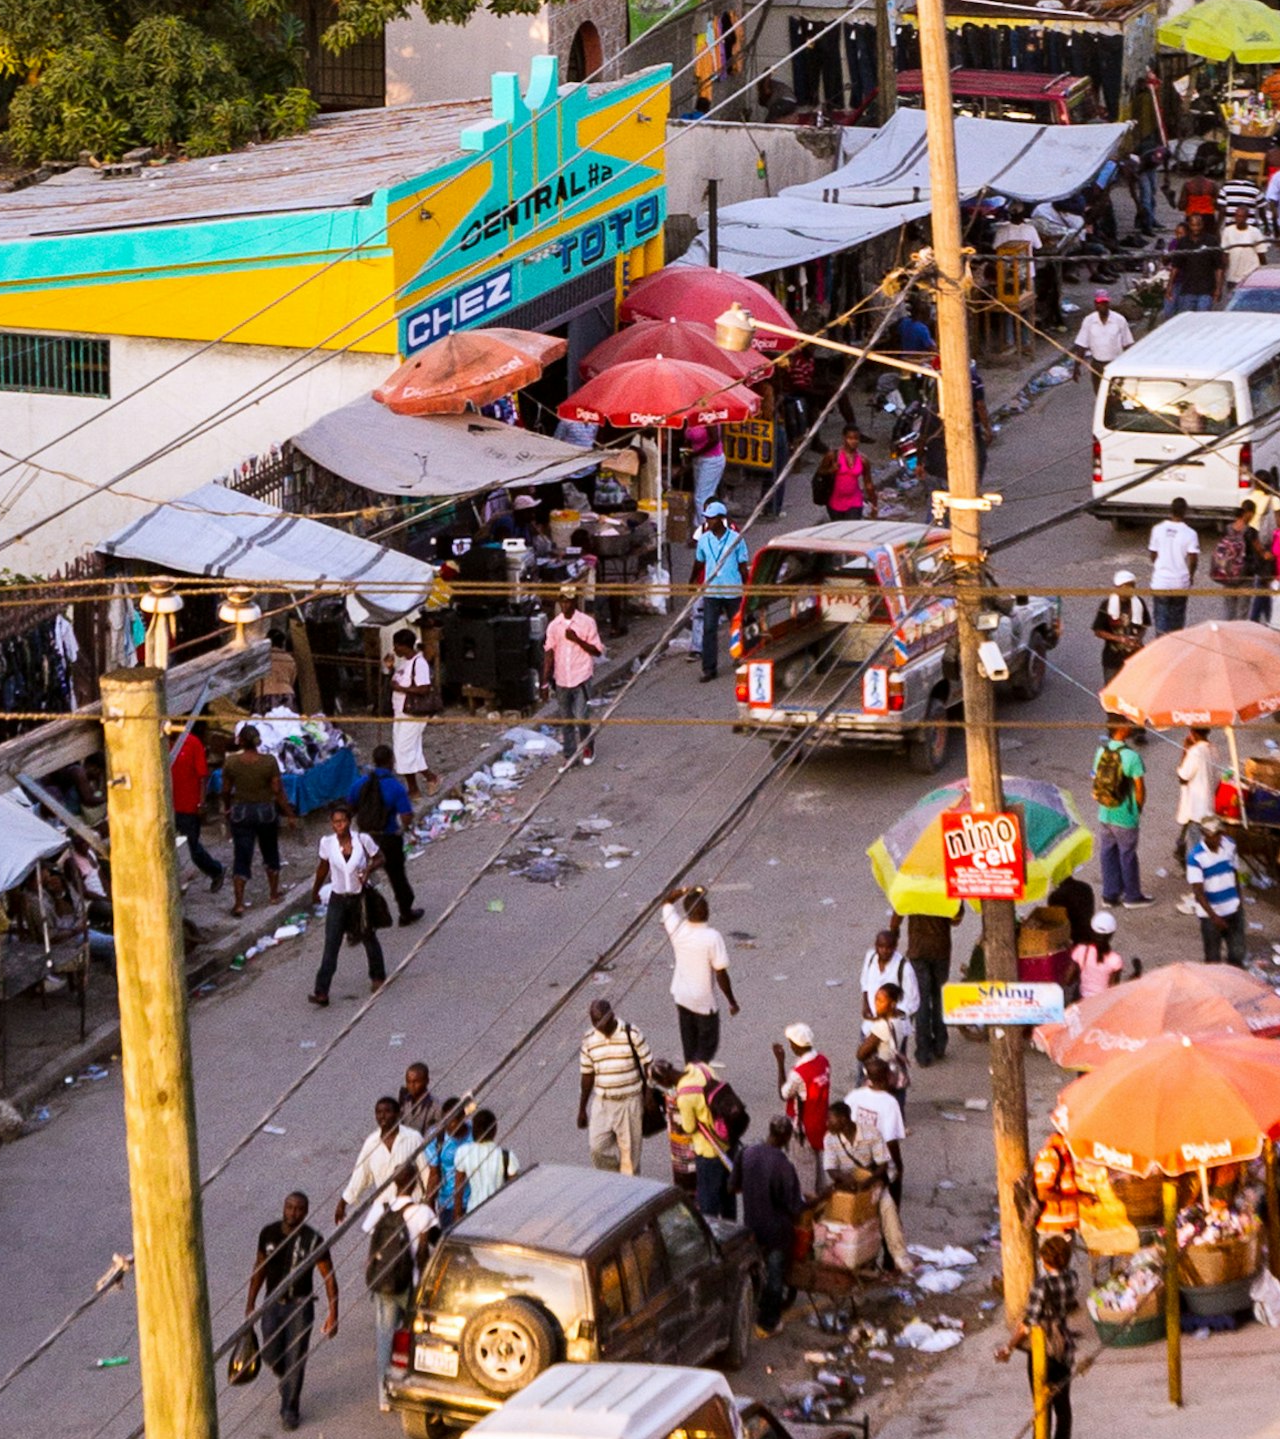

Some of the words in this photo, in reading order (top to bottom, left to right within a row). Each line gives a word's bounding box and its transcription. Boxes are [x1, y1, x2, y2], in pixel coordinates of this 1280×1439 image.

[459, 171, 586, 251] CENTRAL
[407, 272, 512, 348] CHEZ
[559, 194, 659, 274] TOTO
[944, 814, 1017, 860] nino
[972, 842, 1017, 870] cell
[1181, 1138, 1233, 1163] Digicel
